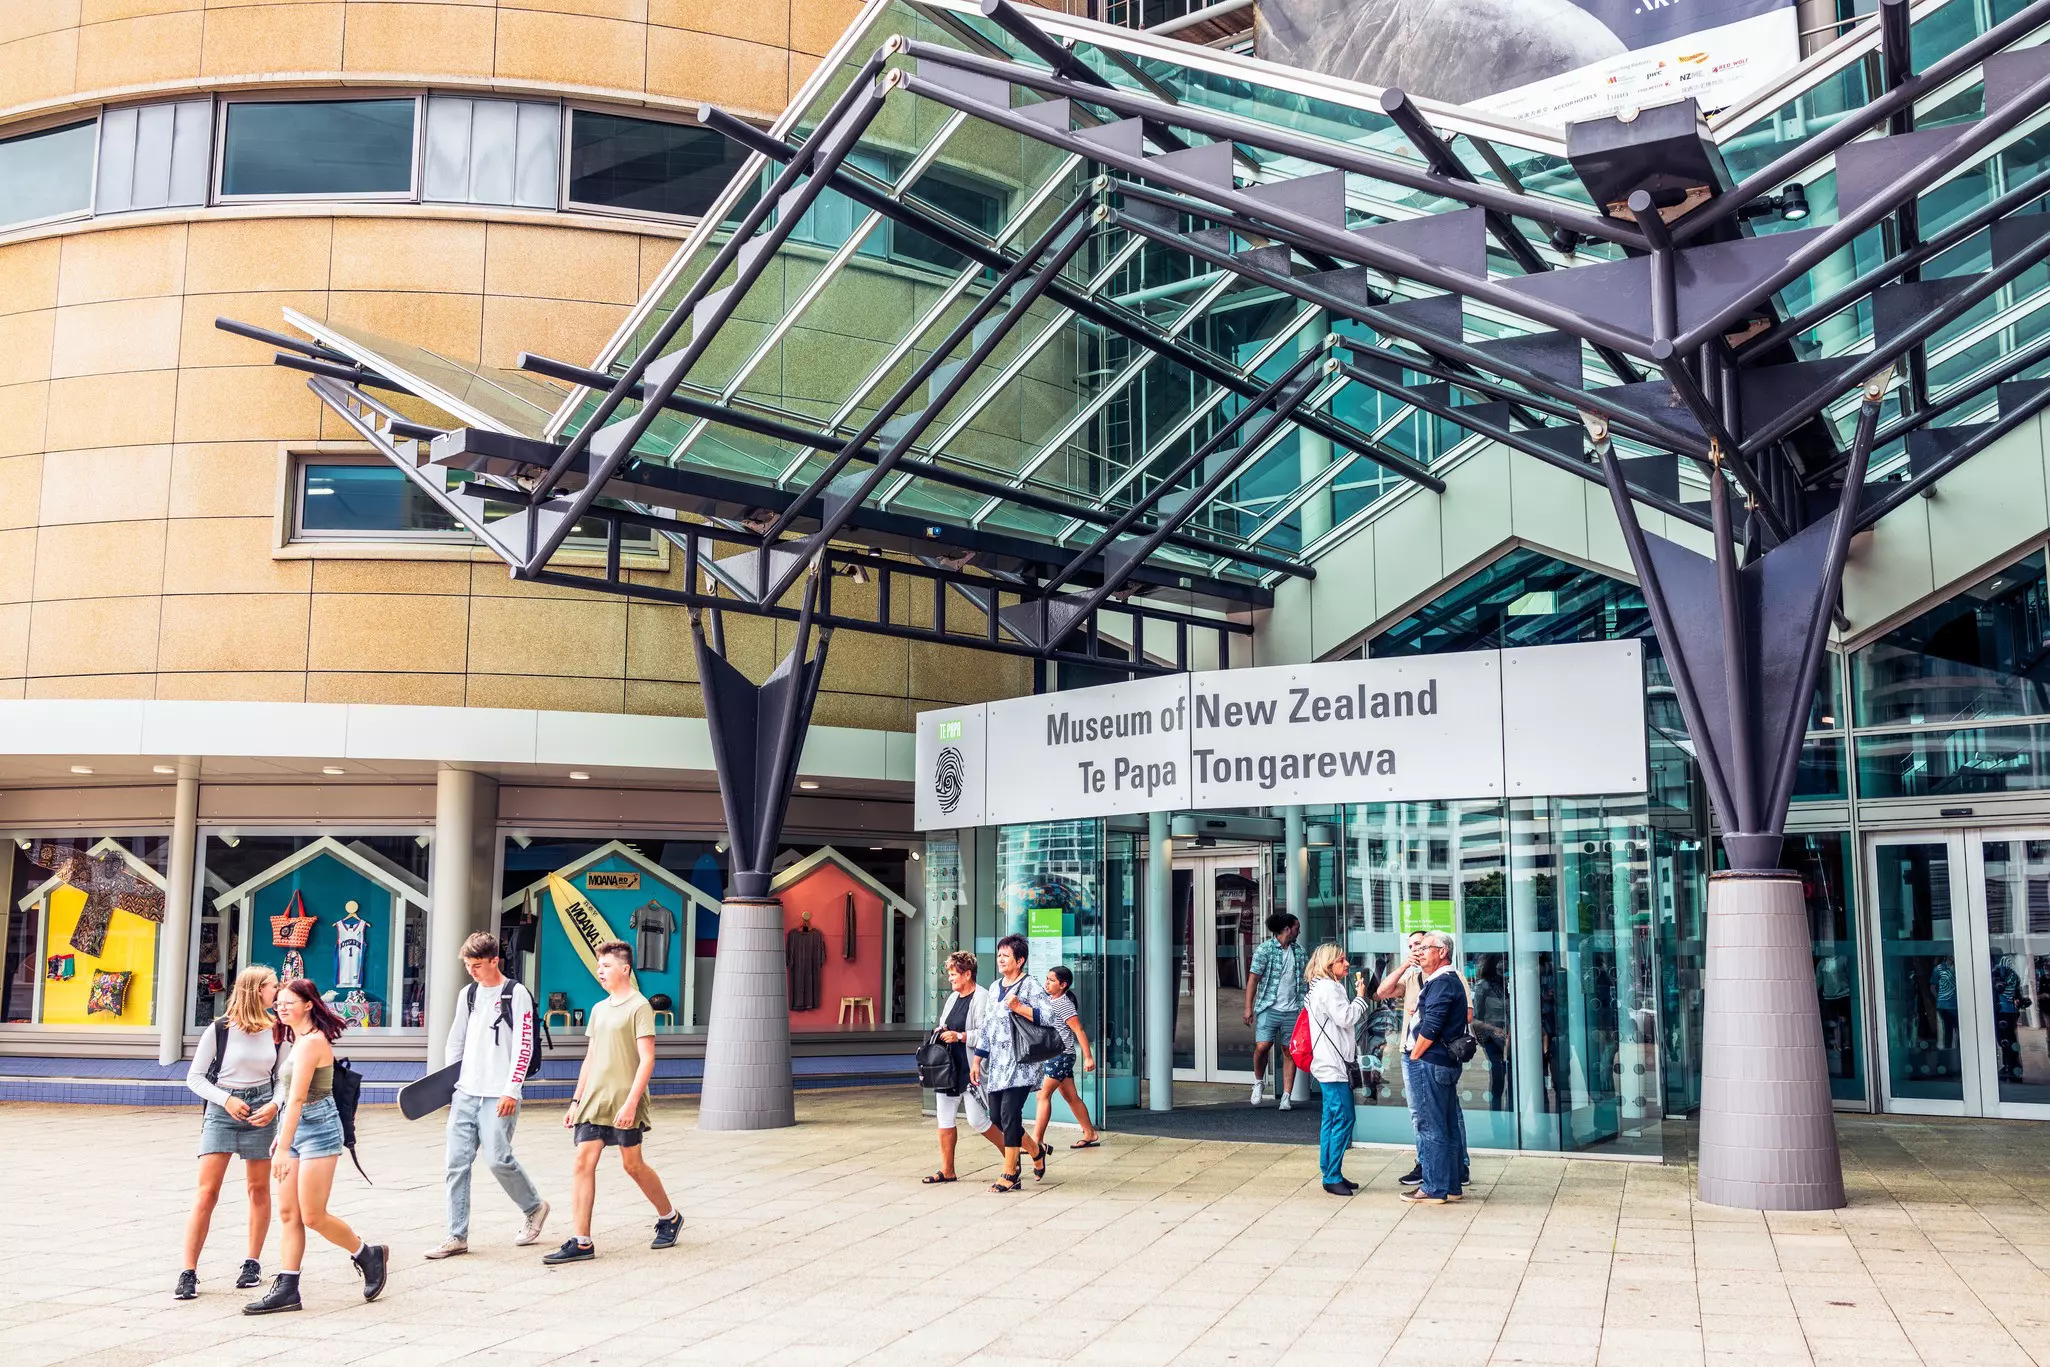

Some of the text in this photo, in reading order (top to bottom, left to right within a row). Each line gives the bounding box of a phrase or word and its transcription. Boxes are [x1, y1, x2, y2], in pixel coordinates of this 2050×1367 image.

[1646, 70, 1663, 80] pwc
[1553, 93, 1597, 111] ACCORHOTELS
[1047, 678, 1438, 746] Museum of New Zealand
[1078, 748, 1396, 798] Te Papa Tongarewa
[588, 875, 629, 886] MOANA RD
[568, 901, 601, 944] MOANA
[348, 946, 353, 957] 1
[511, 1010, 533, 1083] CALIFORNIA
